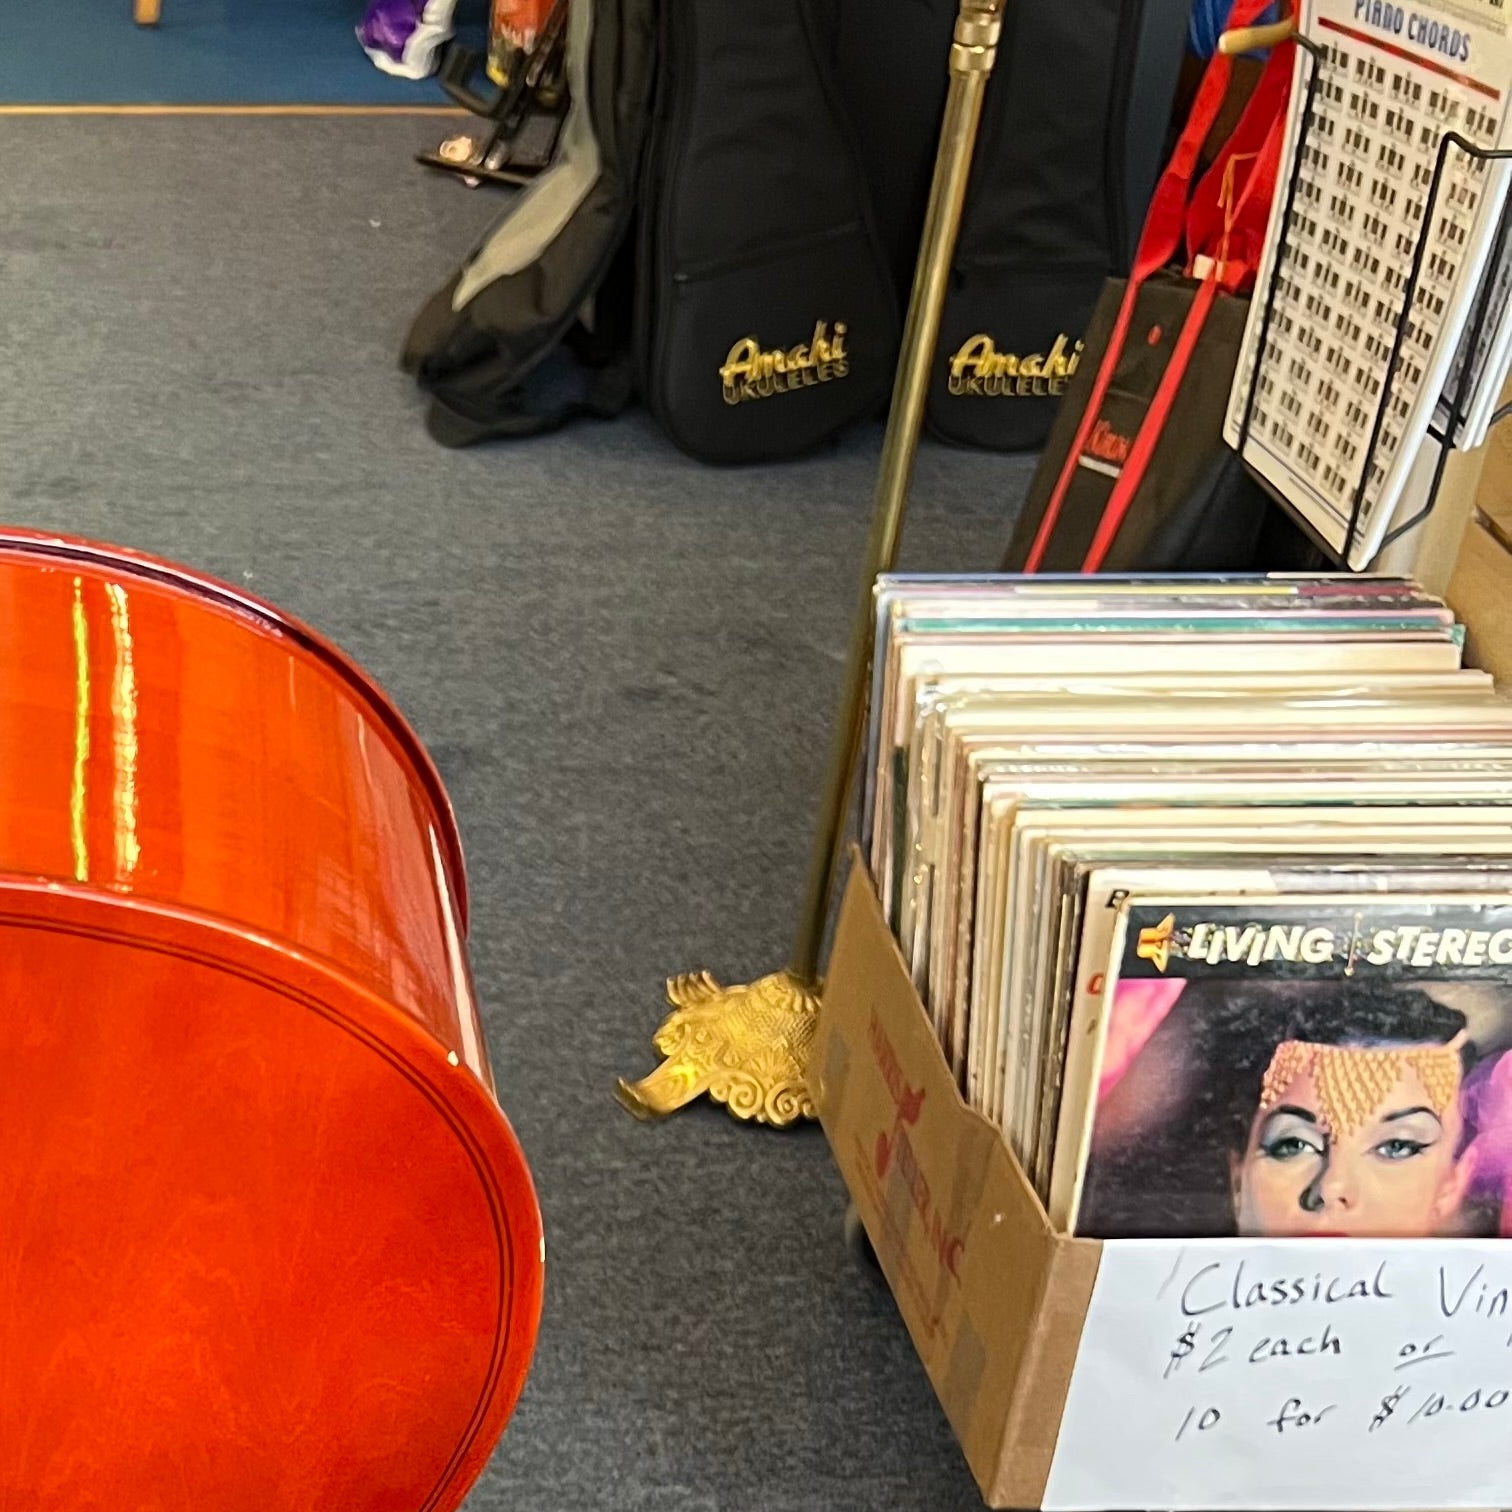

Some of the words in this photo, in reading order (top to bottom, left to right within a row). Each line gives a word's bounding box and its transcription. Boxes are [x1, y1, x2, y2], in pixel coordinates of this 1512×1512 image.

[1408, 13, 1472, 62] CHORDS
[948, 374, 1069, 397] UKULELE
[1188, 922, 1335, 967] LIVING
[1180, 1259, 1393, 1317] Classical
[1163, 1320, 1234, 1381] $2
[1248, 1324, 1342, 1364] each
[1175, 1405, 1221, 1442] 10
[1267, 1397, 1337, 1433] for
